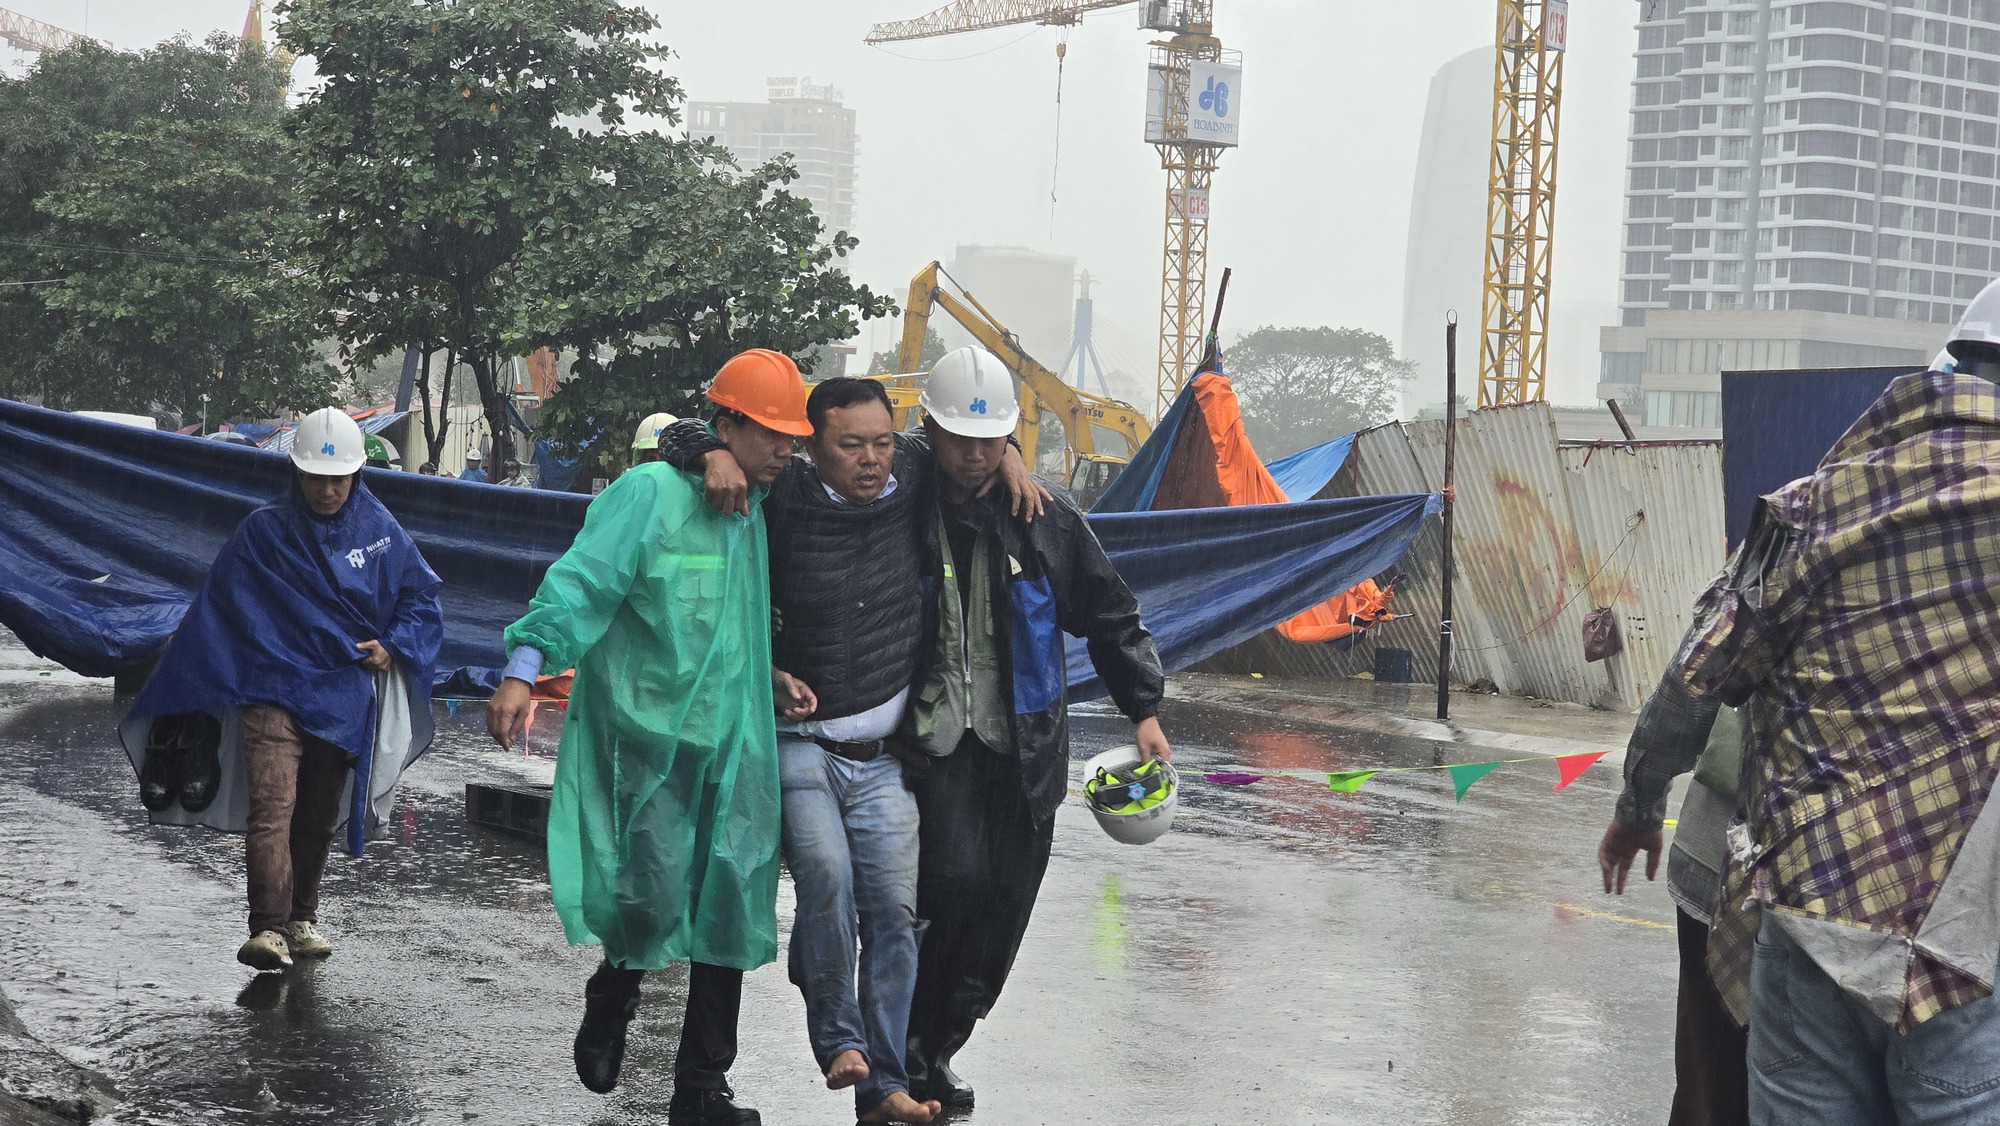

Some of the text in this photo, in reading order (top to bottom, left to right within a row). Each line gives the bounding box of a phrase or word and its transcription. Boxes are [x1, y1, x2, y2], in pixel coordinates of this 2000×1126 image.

[1549, 12, 1565, 44] CT3
[1193, 119, 1233, 134] HOABINH
[1189, 196, 1207, 214] CT5
